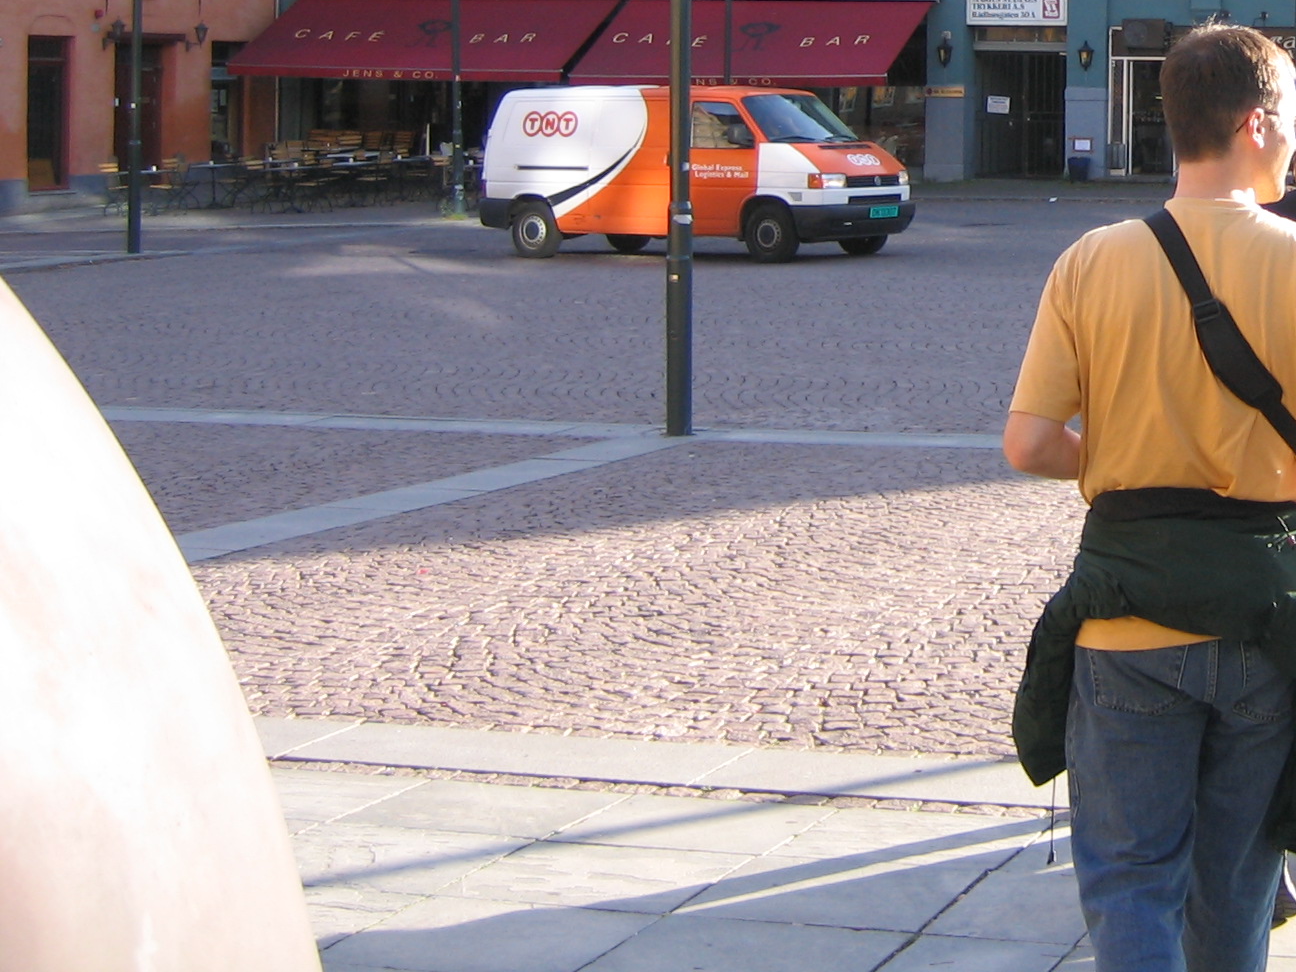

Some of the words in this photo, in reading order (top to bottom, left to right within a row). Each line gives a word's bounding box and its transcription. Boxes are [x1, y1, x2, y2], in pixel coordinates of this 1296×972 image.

[294, 28, 385, 43] CAFÉ
[468, 32, 537, 44] BAR
[612, 32, 708, 48] CAÉ
[799, 34, 870, 47] BAR
[343, 69, 383, 78] JENS
[393, 70, 403, 78] &
